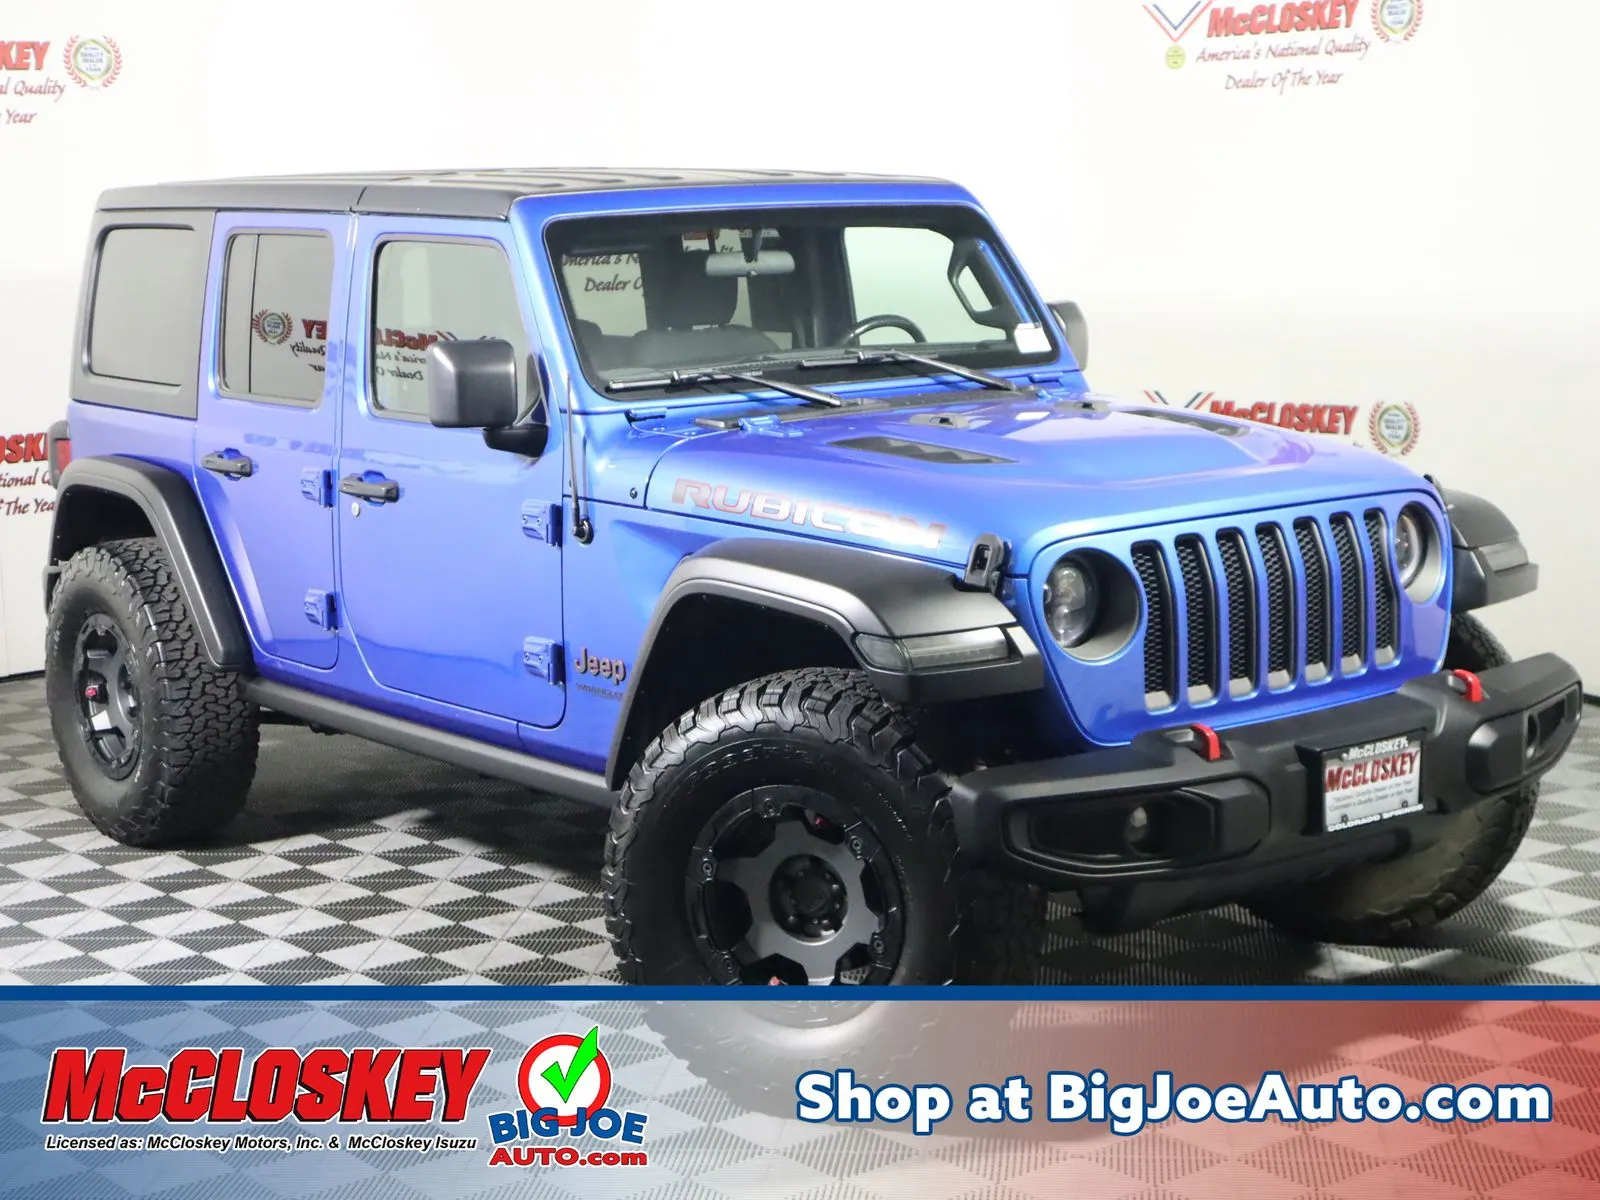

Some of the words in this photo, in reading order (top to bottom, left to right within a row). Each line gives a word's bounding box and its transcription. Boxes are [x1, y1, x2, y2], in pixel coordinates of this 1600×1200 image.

[1207, 0, 1359, 38] McCLOSKEY
[0, 41, 50, 70] KEY
[1196, 42, 1261, 62] America's
[1265, 35, 1323, 59] National
[1325, 33, 1370, 61] Quality
[14, 76, 66, 103] Quality
[1225, 70, 1268, 90] Dealer
[1271, 69, 1291, 95] Of
[1291, 67, 1313, 86] The
[1316, 69, 1344, 86] Year
[6, 109, 37, 125] Year
[584, 273, 631, 292] Dealer
[5, 497, 30, 516] The
[34, 497, 55, 514] Yea
[671, 478, 947, 549] RUBICON
[574, 647, 626, 686] Jeep
[1325, 751, 1417, 792] McCLOSKEY
[1328, 814, 1381, 832] COLORADO
